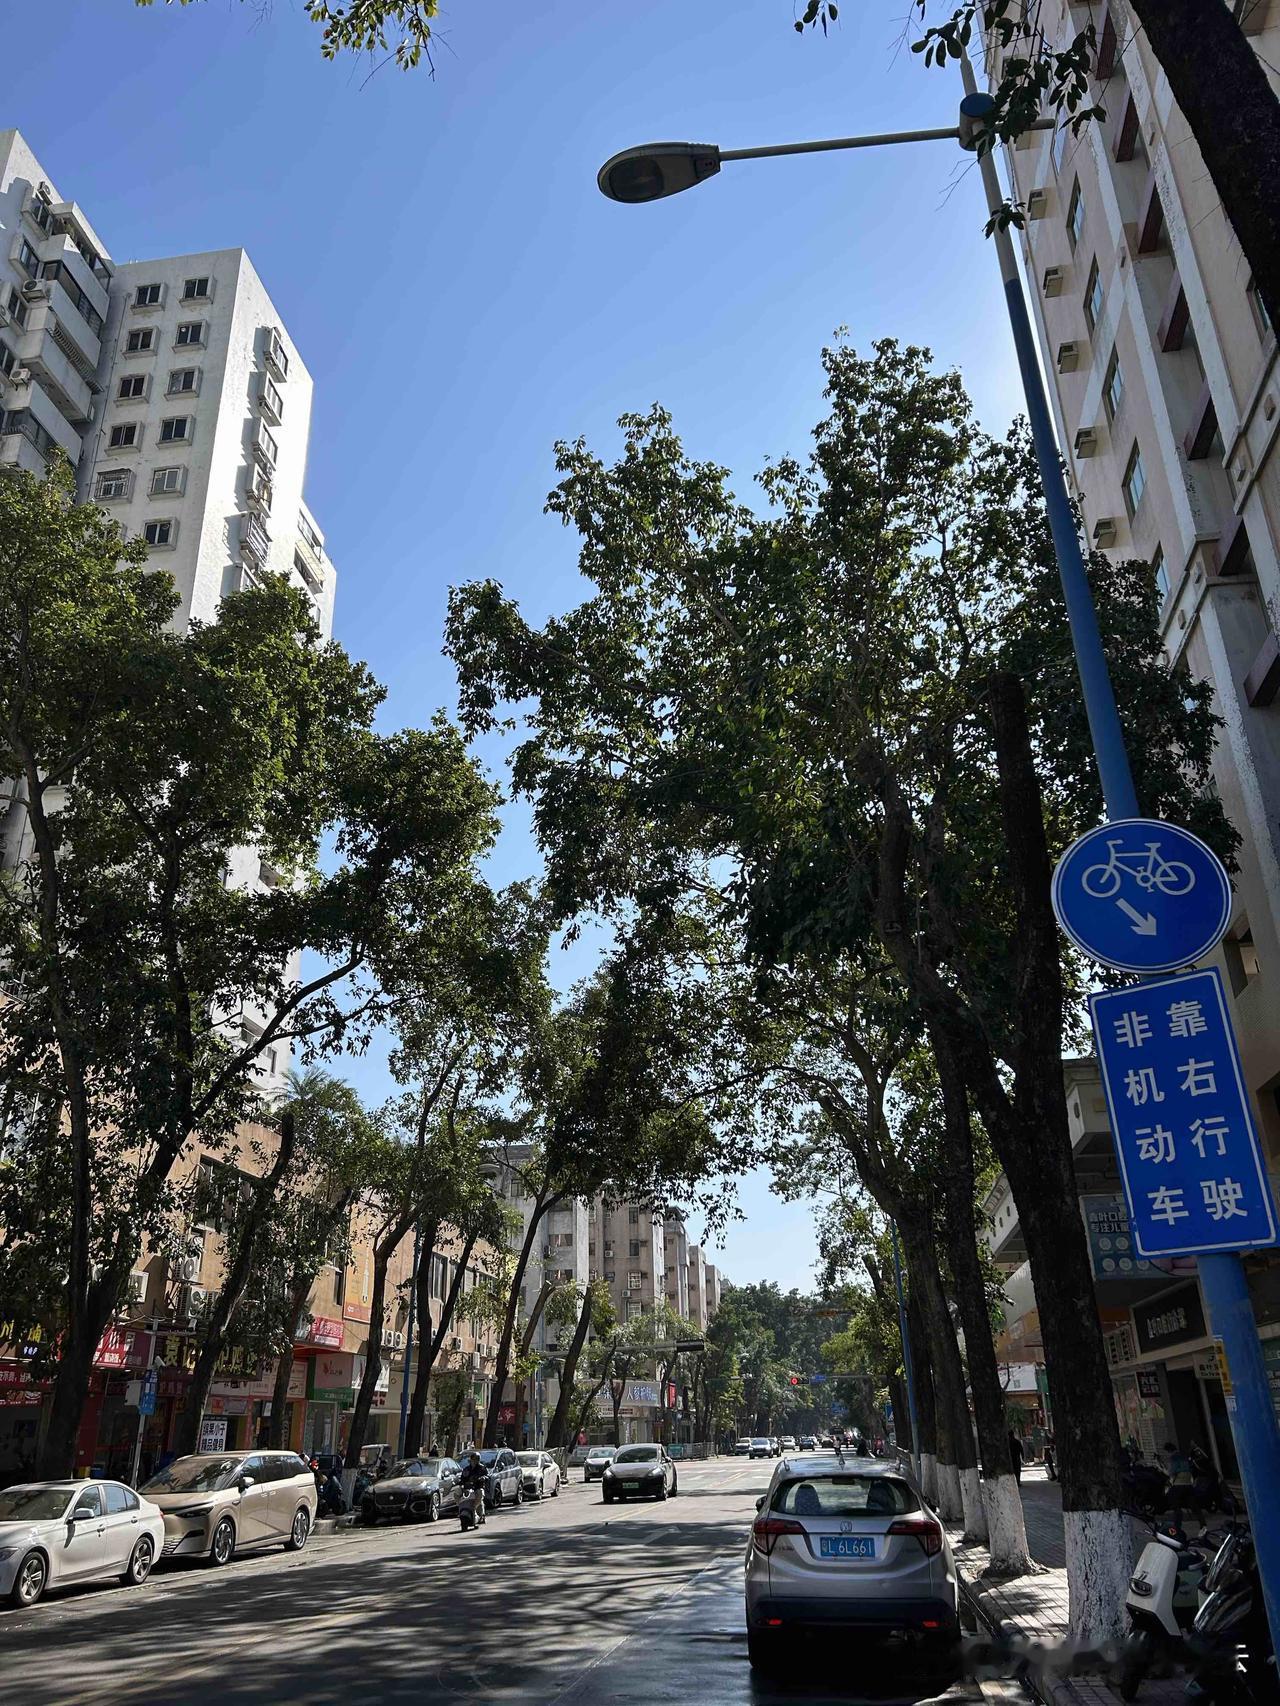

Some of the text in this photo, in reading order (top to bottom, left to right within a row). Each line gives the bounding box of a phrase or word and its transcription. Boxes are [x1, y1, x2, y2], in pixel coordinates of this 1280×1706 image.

[1113, 1010, 1190, 1227] 非机动车
[1166, 1000, 1249, 1222] 靠右行驶
